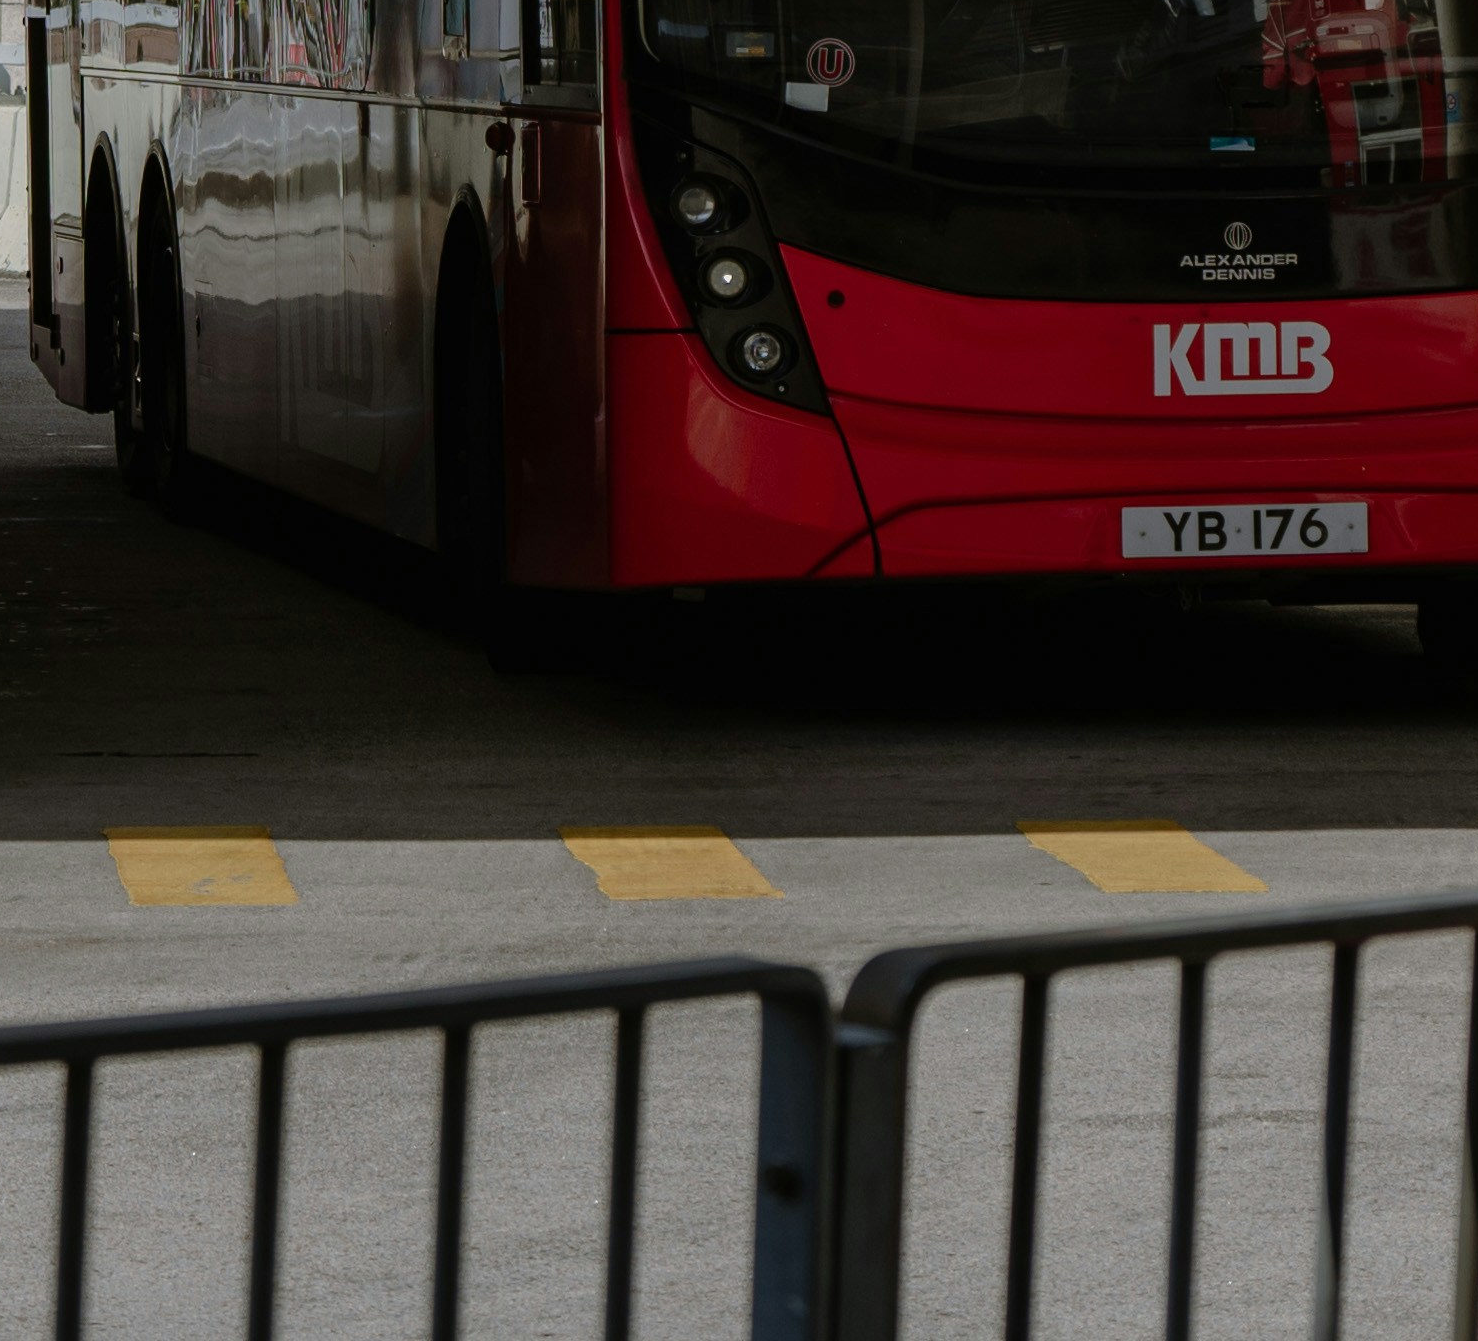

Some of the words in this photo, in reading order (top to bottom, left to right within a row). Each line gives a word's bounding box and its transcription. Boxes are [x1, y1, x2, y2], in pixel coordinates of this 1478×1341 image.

[1180, 253, 1298, 267] ALEXANDER
[1202, 268, 1276, 281] DENNIS
[1153, 321, 1334, 397] KMB
[1162, 510, 1228, 552] YB
[1252, 507, 1329, 550] 176
